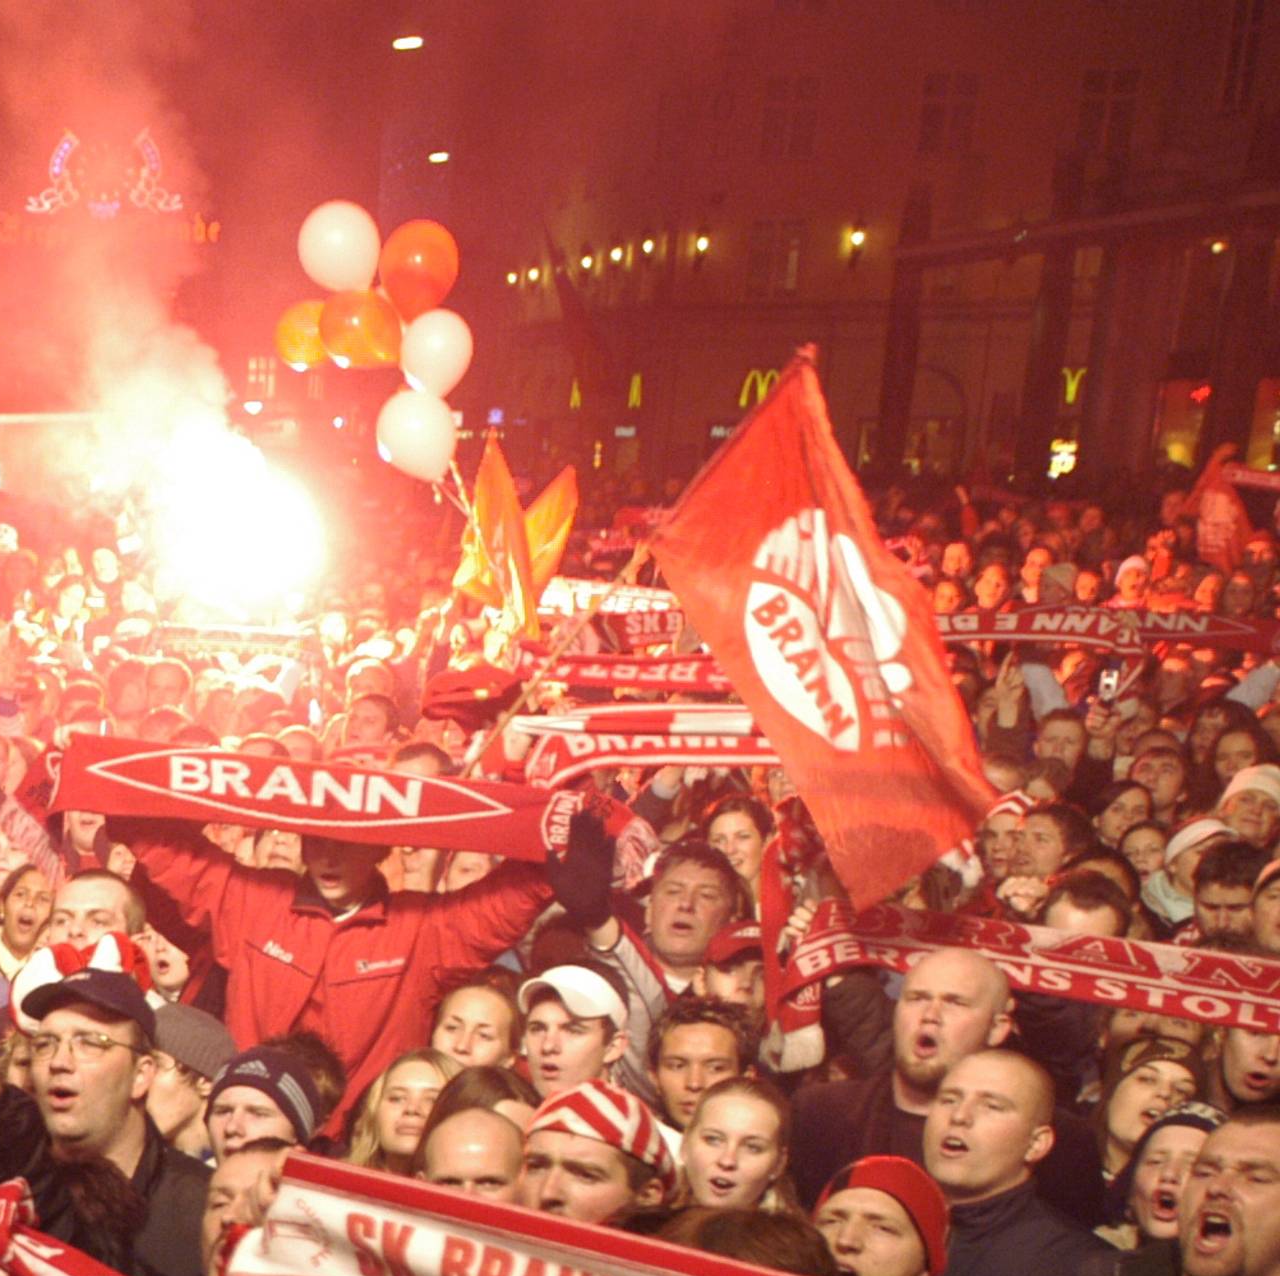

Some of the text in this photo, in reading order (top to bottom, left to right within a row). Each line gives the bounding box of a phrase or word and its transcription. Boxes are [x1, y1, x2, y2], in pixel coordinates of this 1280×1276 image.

[746, 592, 857, 742] BRANN
[168, 755, 423, 818] BRANN
[795, 939, 1073, 991] BERNS
